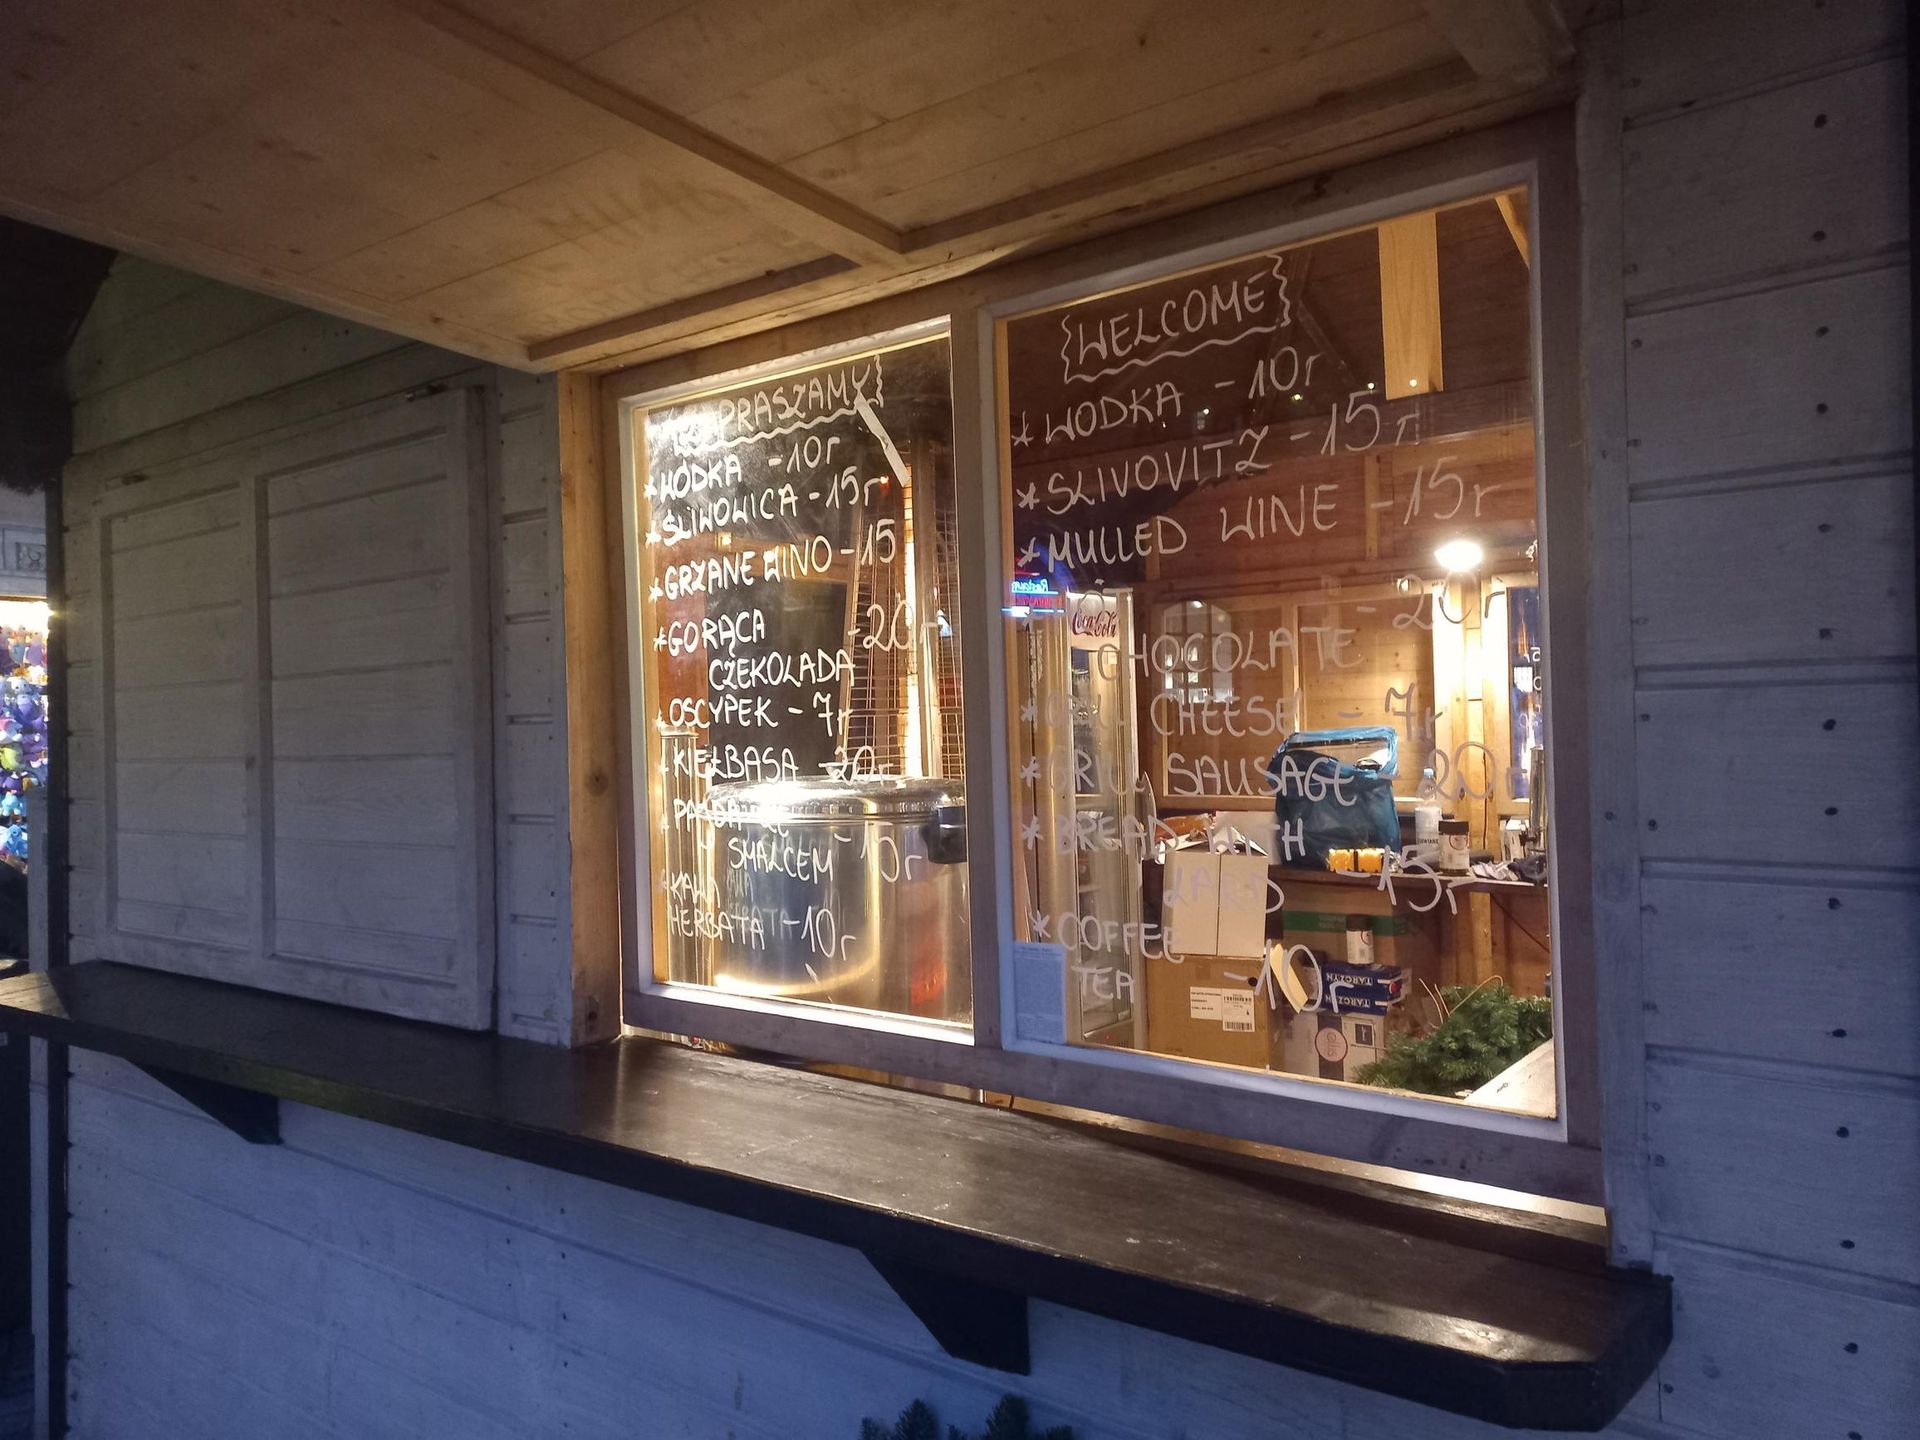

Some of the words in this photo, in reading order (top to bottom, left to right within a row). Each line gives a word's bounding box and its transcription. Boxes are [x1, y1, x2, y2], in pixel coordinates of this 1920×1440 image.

[1079, 270, 1267, 365] WELCOME
[1046, 382, 1183, 444] WODKA
[660, 454, 742, 504] WODKA
[1046, 425, 1272, 515] SLIVOVITZ
[1047, 515, 1187, 573] MULLED
[1221, 484, 1338, 542] WINE
[664, 551, 755, 600] GRZANE
[762, 535, 833, 584] WINO
[668, 608, 765, 658] GORĄCA
[1097, 626, 1364, 682] CHOCOLATE
[669, 696, 778, 729] OSCYPEK
[1150, 693, 1302, 739] CHEESE
[673, 743, 800, 784] KIEŁBASA
[1168, 754, 1358, 807] SAUSAGE
[728, 837, 834, 885] SMALCEM
[1058, 911, 1185, 964] COFFEE
[1071, 966, 1136, 1004] TEA
